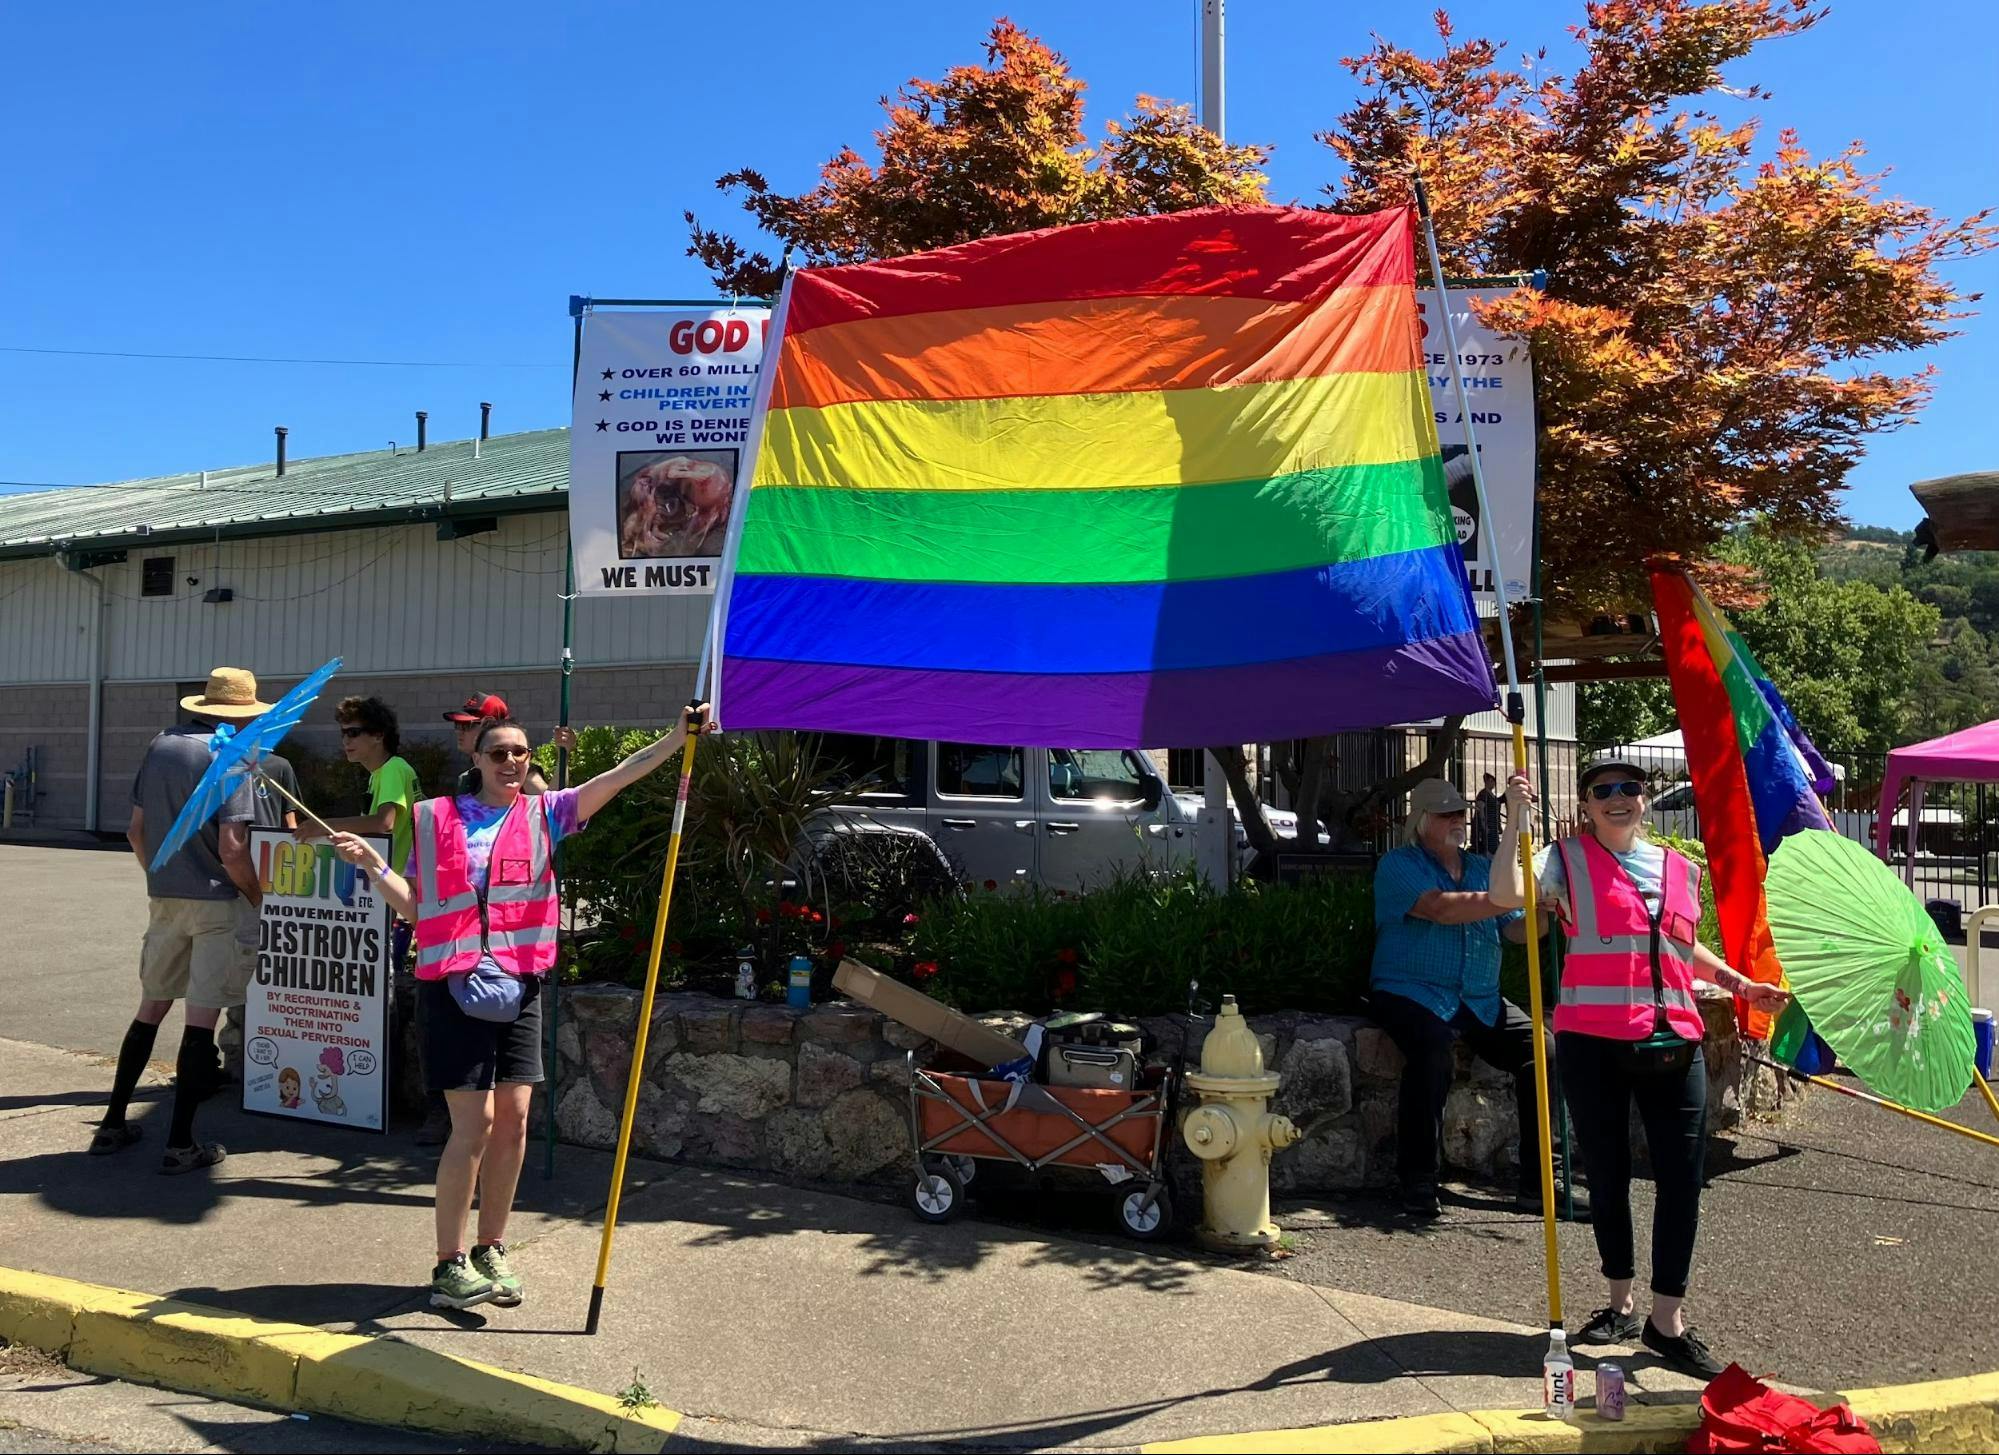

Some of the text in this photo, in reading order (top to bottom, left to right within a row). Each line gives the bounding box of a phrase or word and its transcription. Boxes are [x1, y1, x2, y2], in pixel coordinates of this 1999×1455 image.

[670, 320, 749, 355] GOD
[1458, 354, 1503, 365] 1973
[622, 367, 673, 379] OVER
[679, 365, 700, 376] 60
[1462, 377, 1503, 388] THE
[619, 385, 748, 399] CHILDREN IN
[659, 398, 750, 411] PERVERT
[616, 418, 750, 432] GOD IS DENIE
[656, 433, 685, 444] WE
[601, 565, 711, 588] WE MUST
[264, 904, 369, 924] MOVEMENT
[258, 919, 379, 963] DESTROYS
[256, 953, 375, 997] CHILDREN
[267, 991, 361, 1011] BY RECRUITING &
[268, 1004, 360, 1023] INDOCTRINATING
[284, 1017, 343, 1033] THEM INTO
[257, 1026, 370, 1049] SEXUAL PERVERSION
[358, 1055, 372, 1063] CAN
[1551, 1372, 1564, 1404] hint
